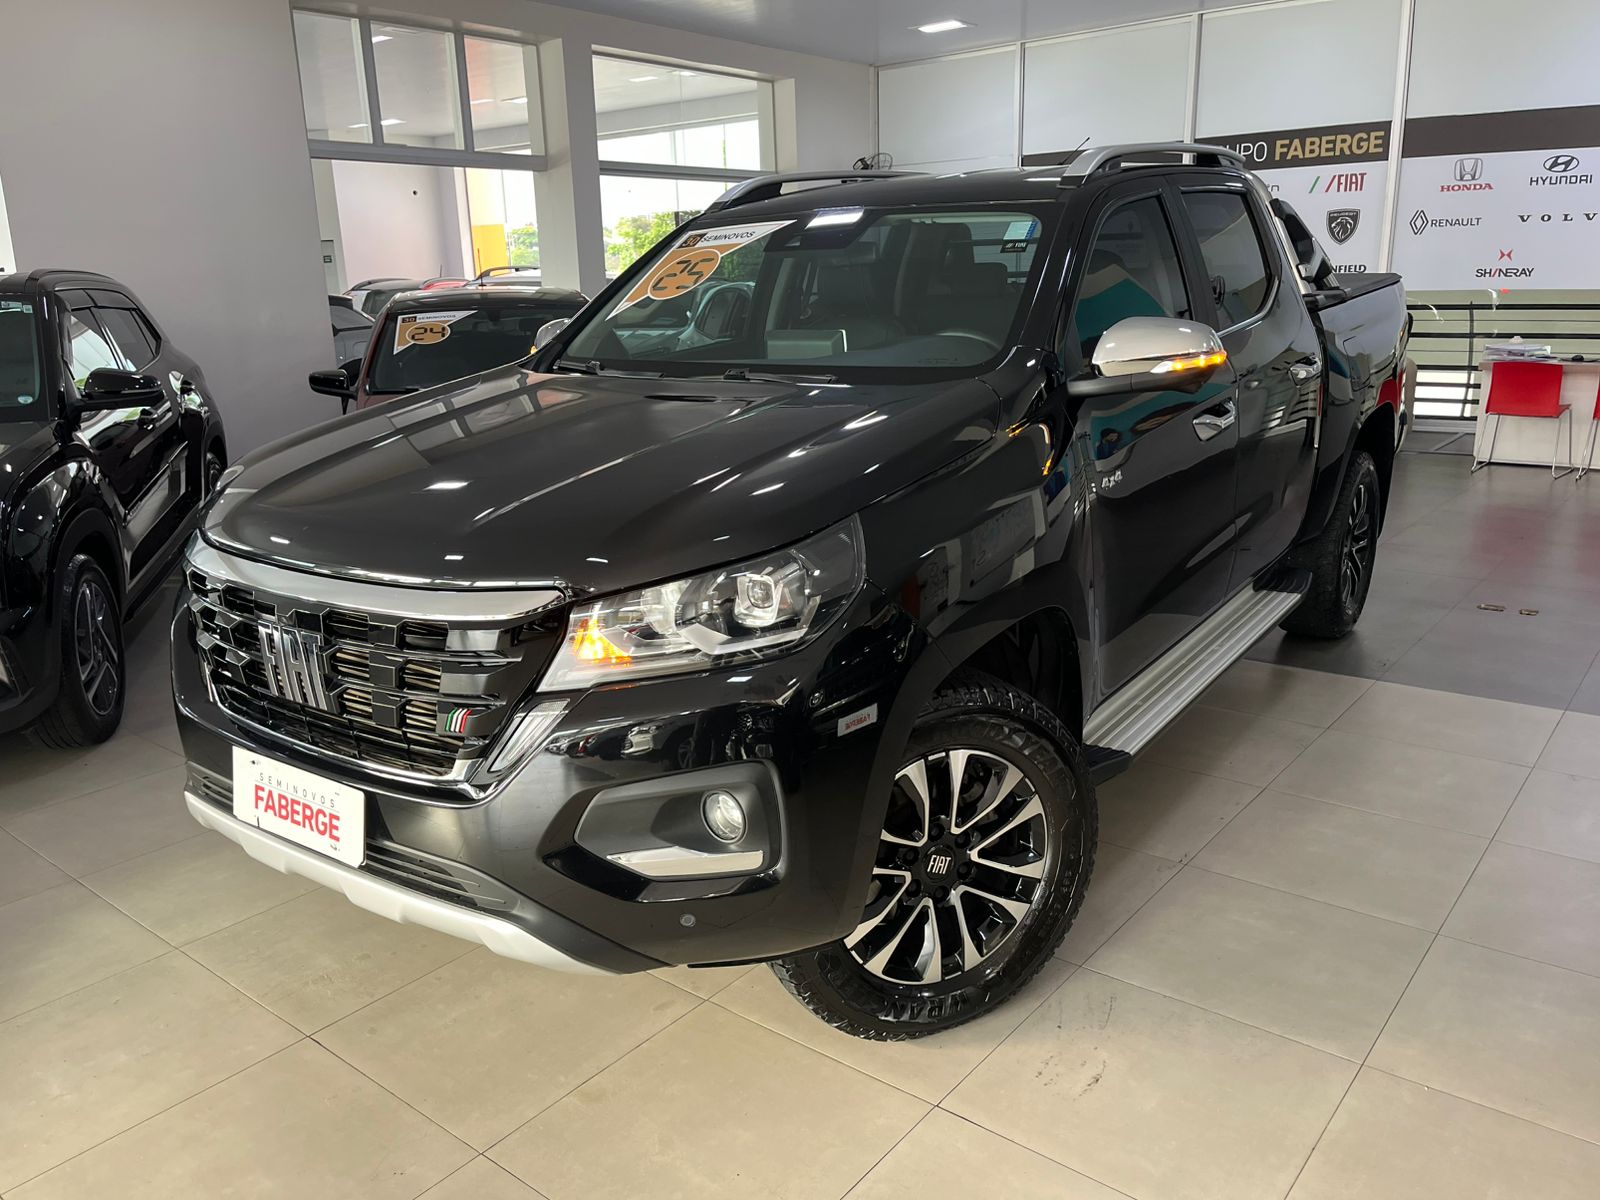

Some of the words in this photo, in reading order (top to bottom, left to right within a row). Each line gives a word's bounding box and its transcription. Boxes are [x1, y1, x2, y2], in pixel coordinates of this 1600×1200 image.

[1275, 131, 1385, 161] FABERGE
[1337, 173, 1367, 193] FIAT
[1440, 183, 1494, 192] HONDA
[1530, 174, 1592, 186] HYUNDAI
[1430, 217, 1482, 227] RENAULT
[701, 231, 756, 243] SEMINOVOS
[652, 258, 715, 290] 25
[1475, 268, 1535, 278] SHINERAY
[411, 326, 446, 340] 24
[258, 620, 328, 711] FIAT
[259, 772, 335, 808] SEMINOVOS
[254, 784, 341, 842] FABERGE
[926, 854, 951, 875] FIAT
